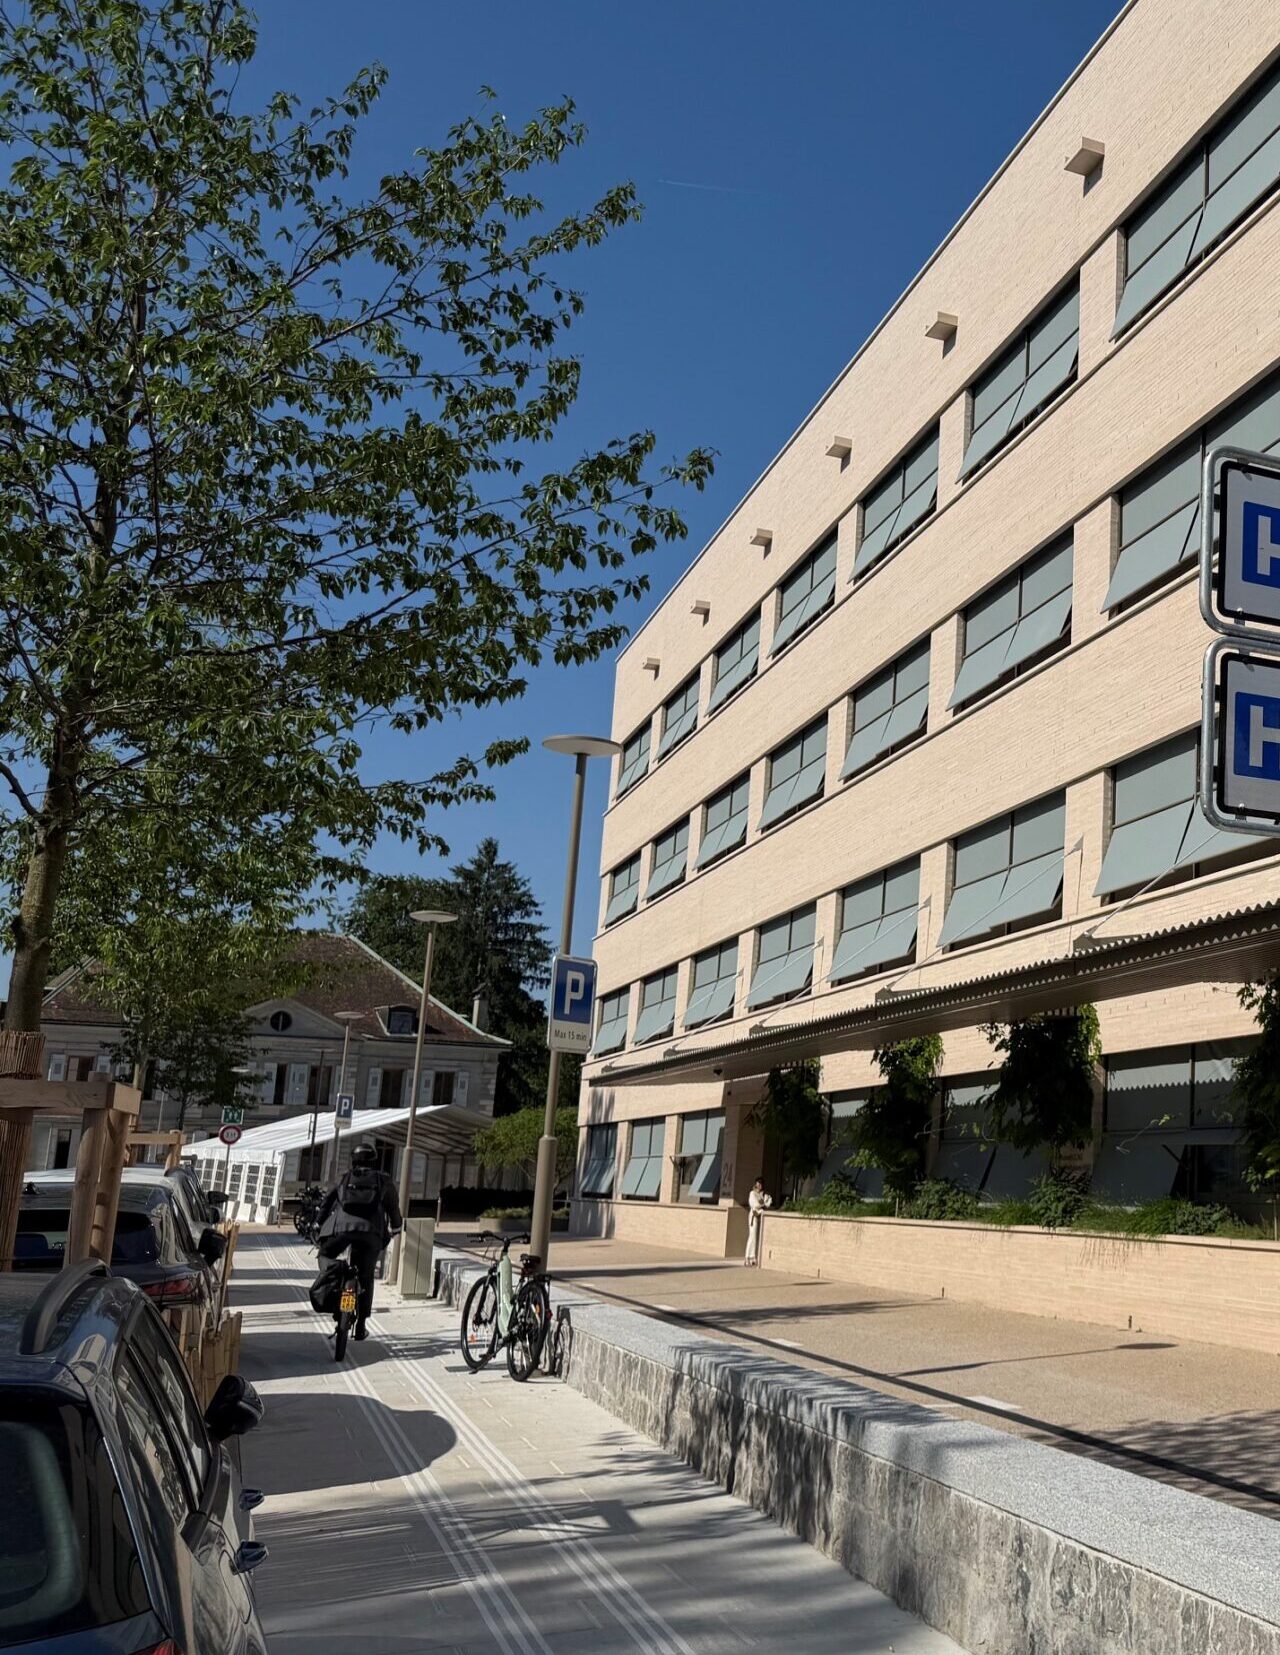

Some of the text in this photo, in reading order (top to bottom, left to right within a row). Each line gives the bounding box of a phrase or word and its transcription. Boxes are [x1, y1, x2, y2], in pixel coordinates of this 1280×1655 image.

[564, 970, 585, 1015] P
[569, 1030, 575, 1040] 15
[340, 1098, 350, 1117] P
